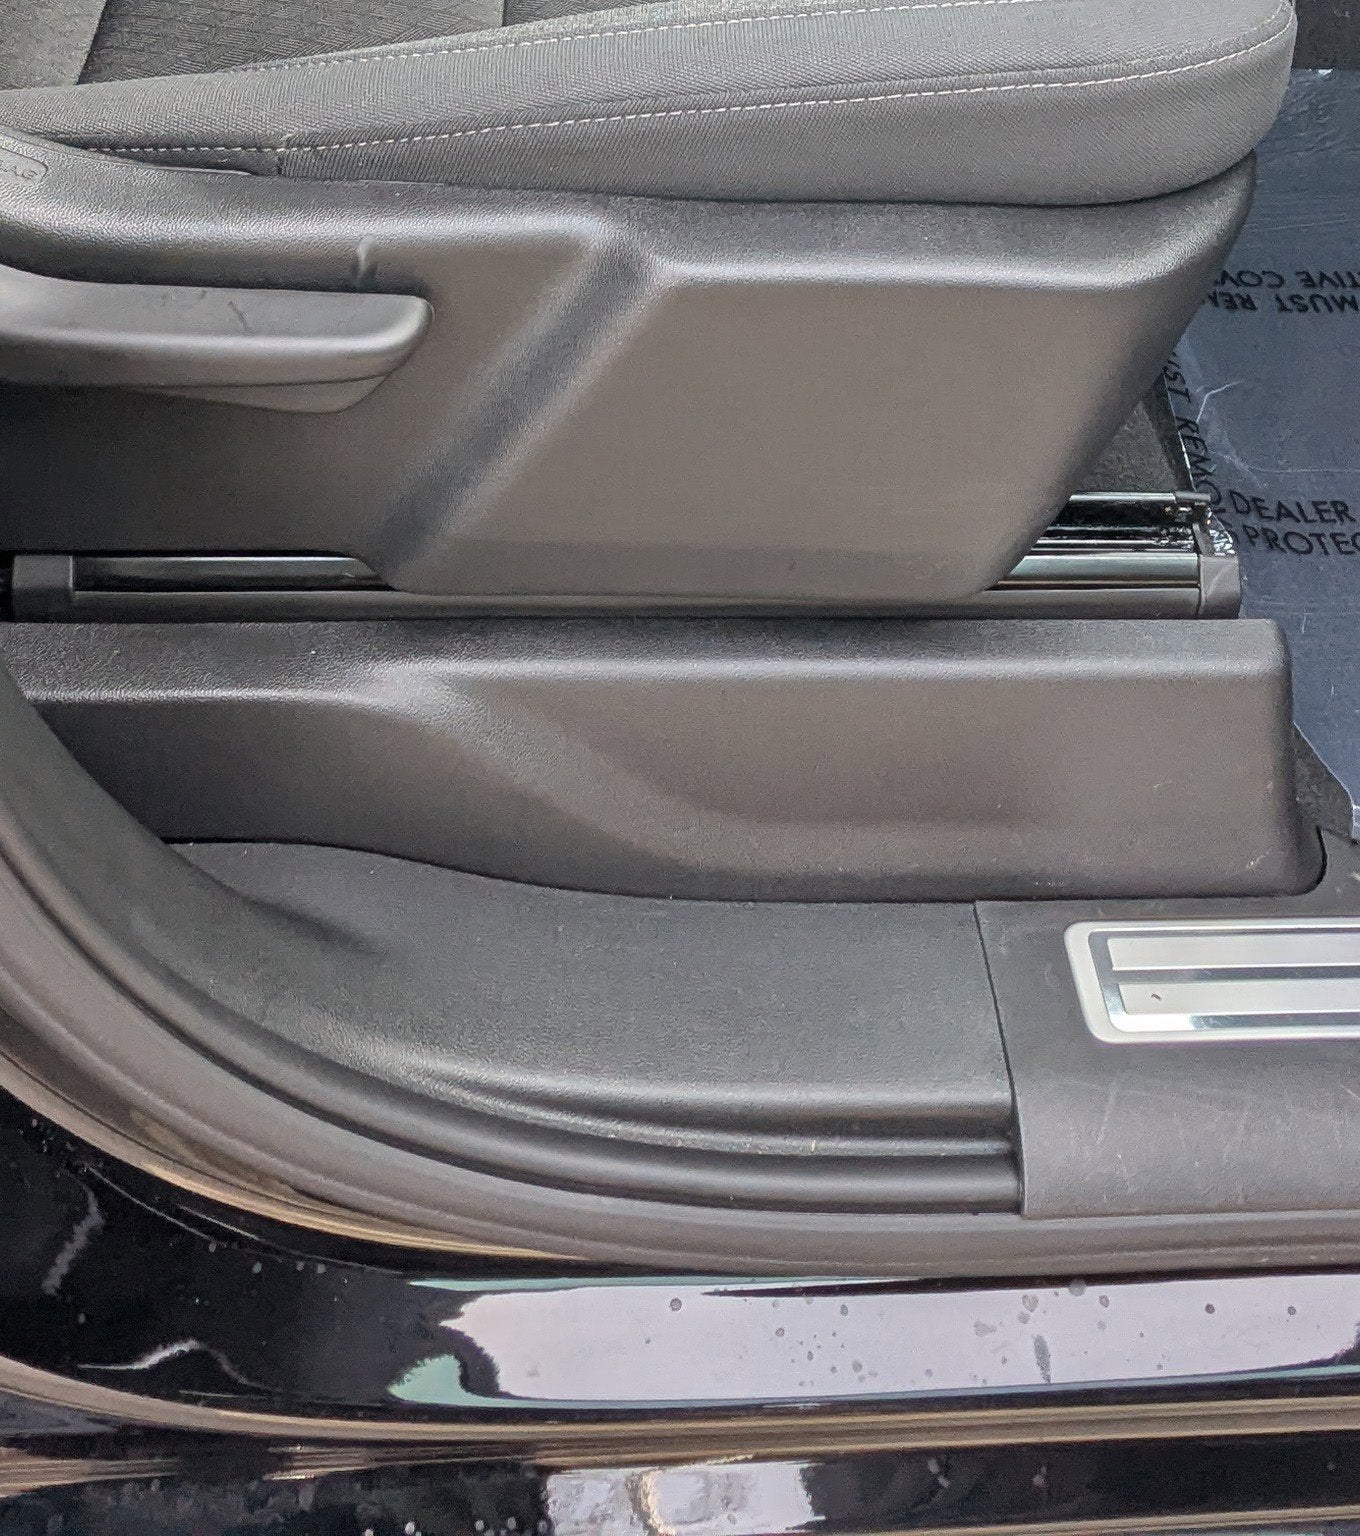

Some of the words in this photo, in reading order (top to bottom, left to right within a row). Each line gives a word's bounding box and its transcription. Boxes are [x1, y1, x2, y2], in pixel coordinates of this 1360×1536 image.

[1213, 269, 1286, 289] COV
[1274, 292, 1360, 314] MUST
[1227, 489, 1357, 524] DEALER
